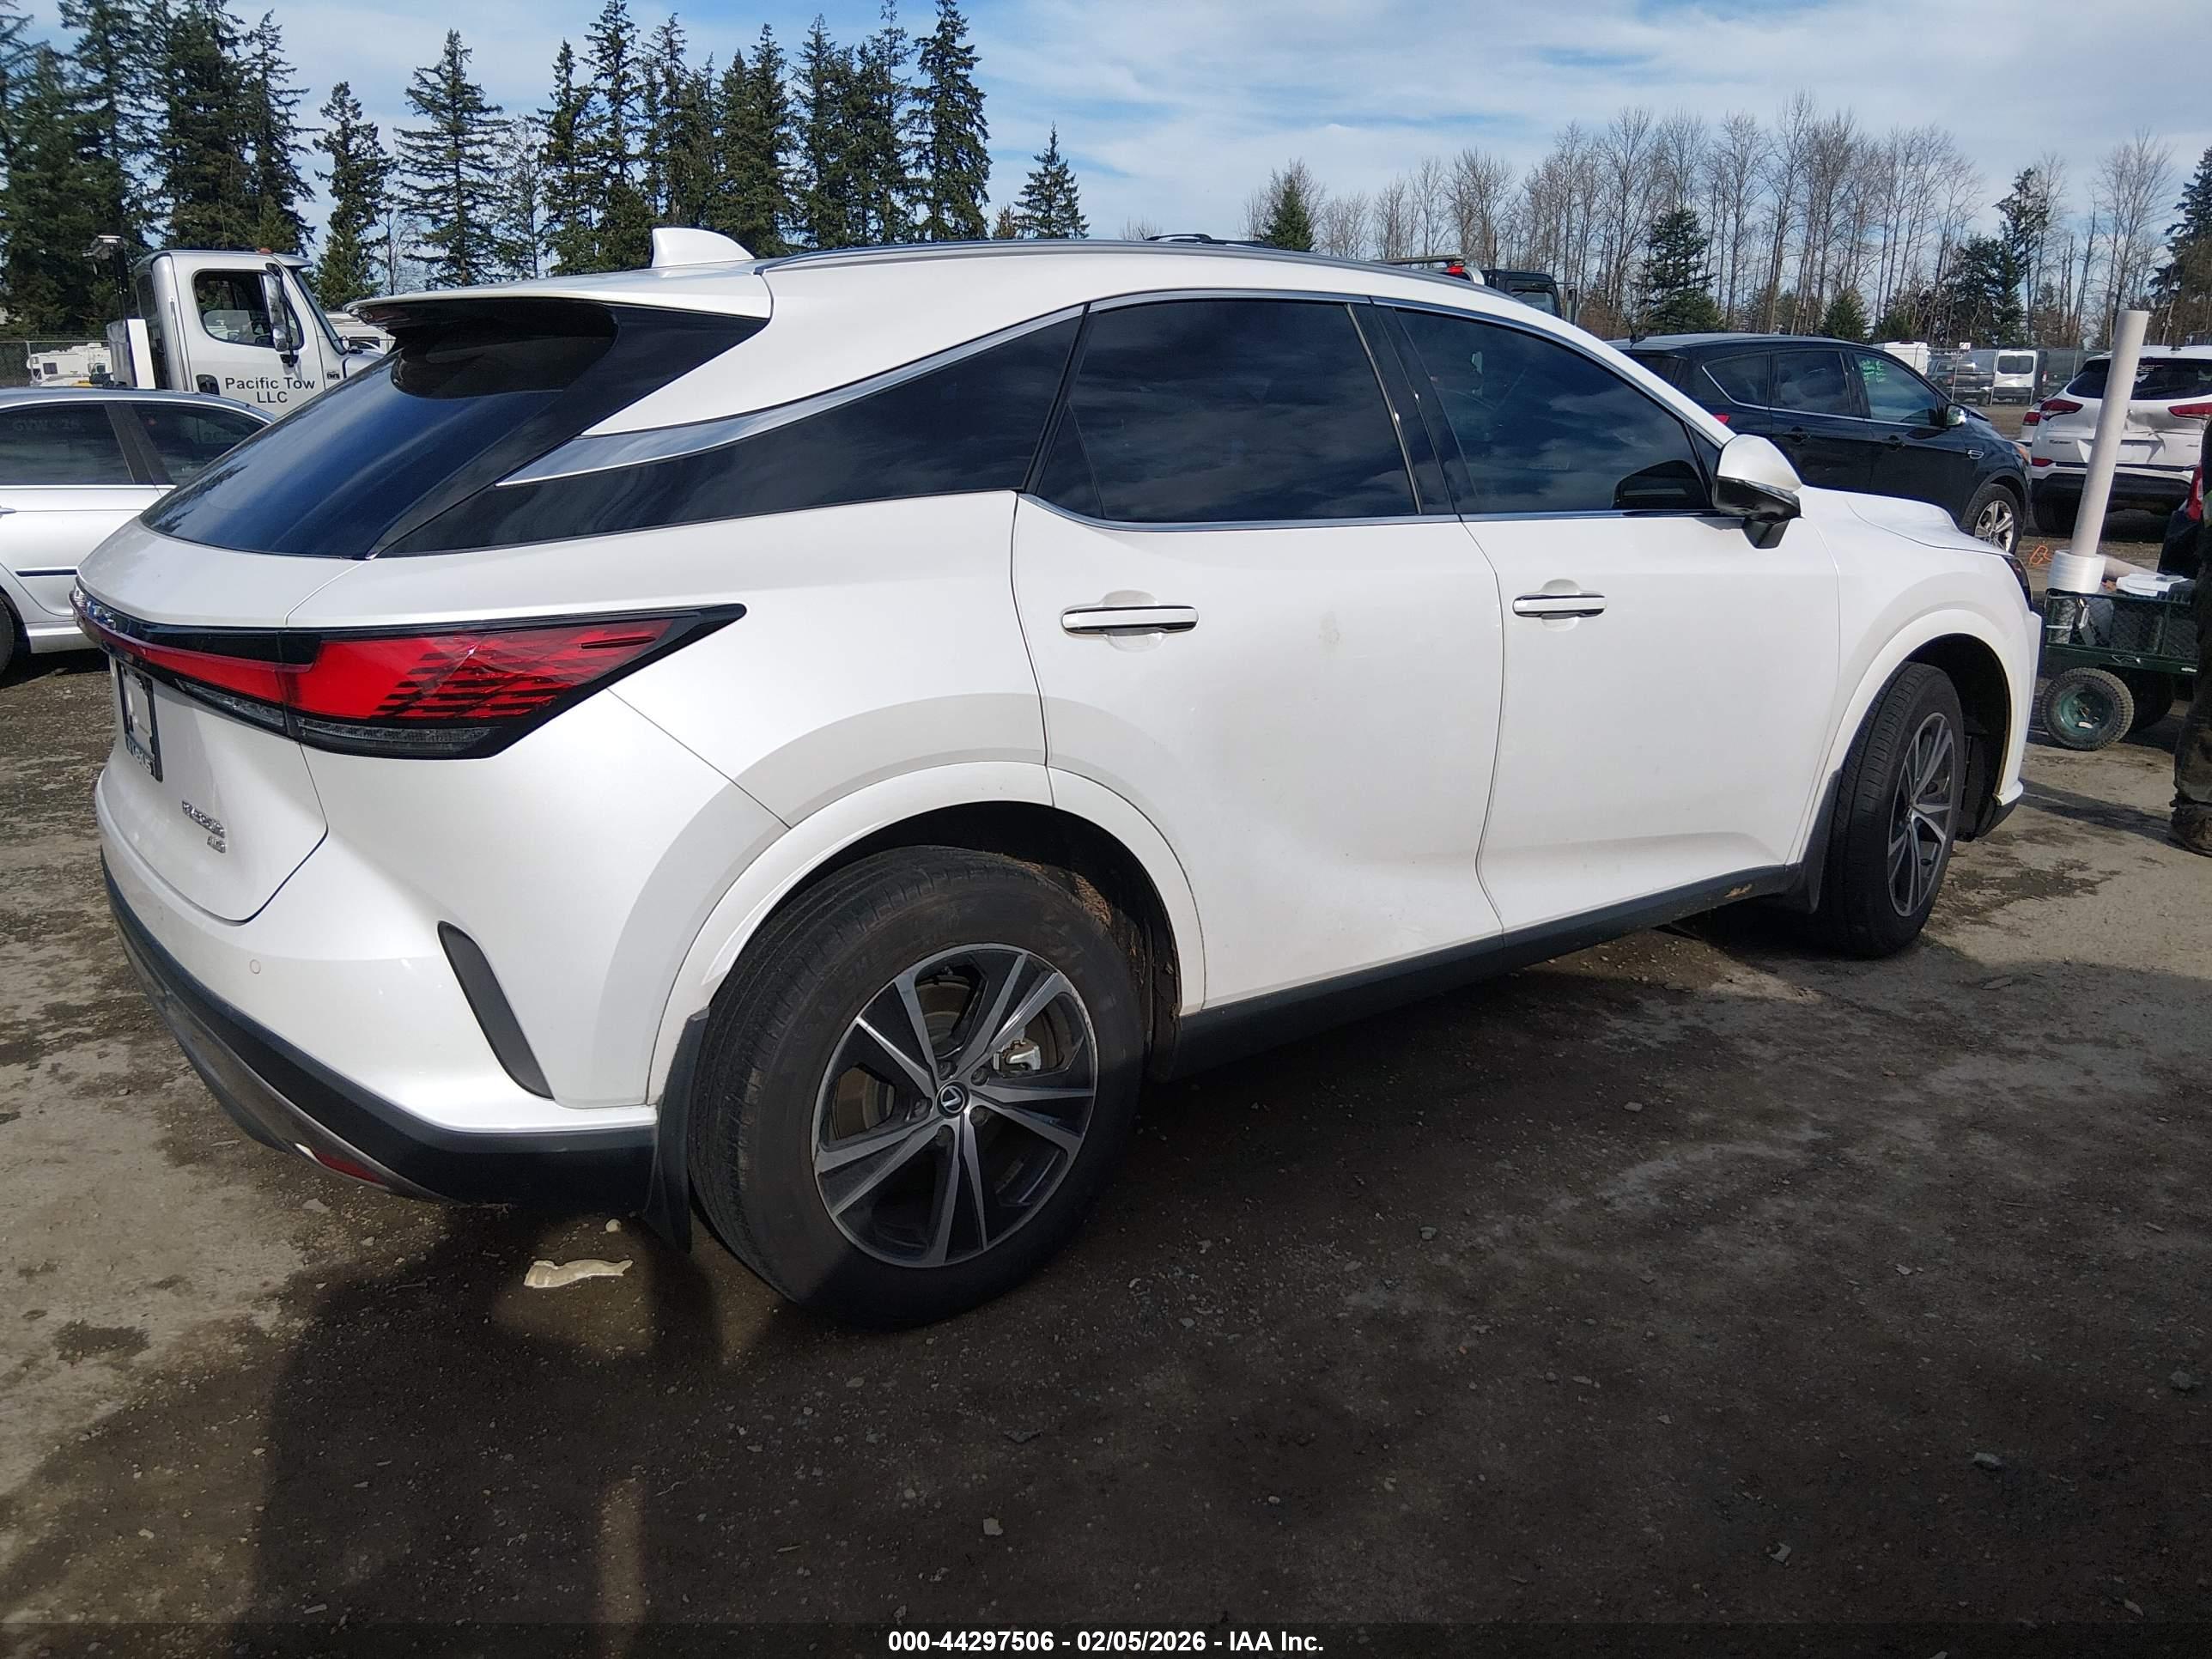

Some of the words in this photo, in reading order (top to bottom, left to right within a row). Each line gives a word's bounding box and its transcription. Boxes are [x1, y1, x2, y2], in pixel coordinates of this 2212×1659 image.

[225, 377, 279, 390] Pacific
[283, 377, 315, 390] Tow
[256, 391, 288, 404] LLC
